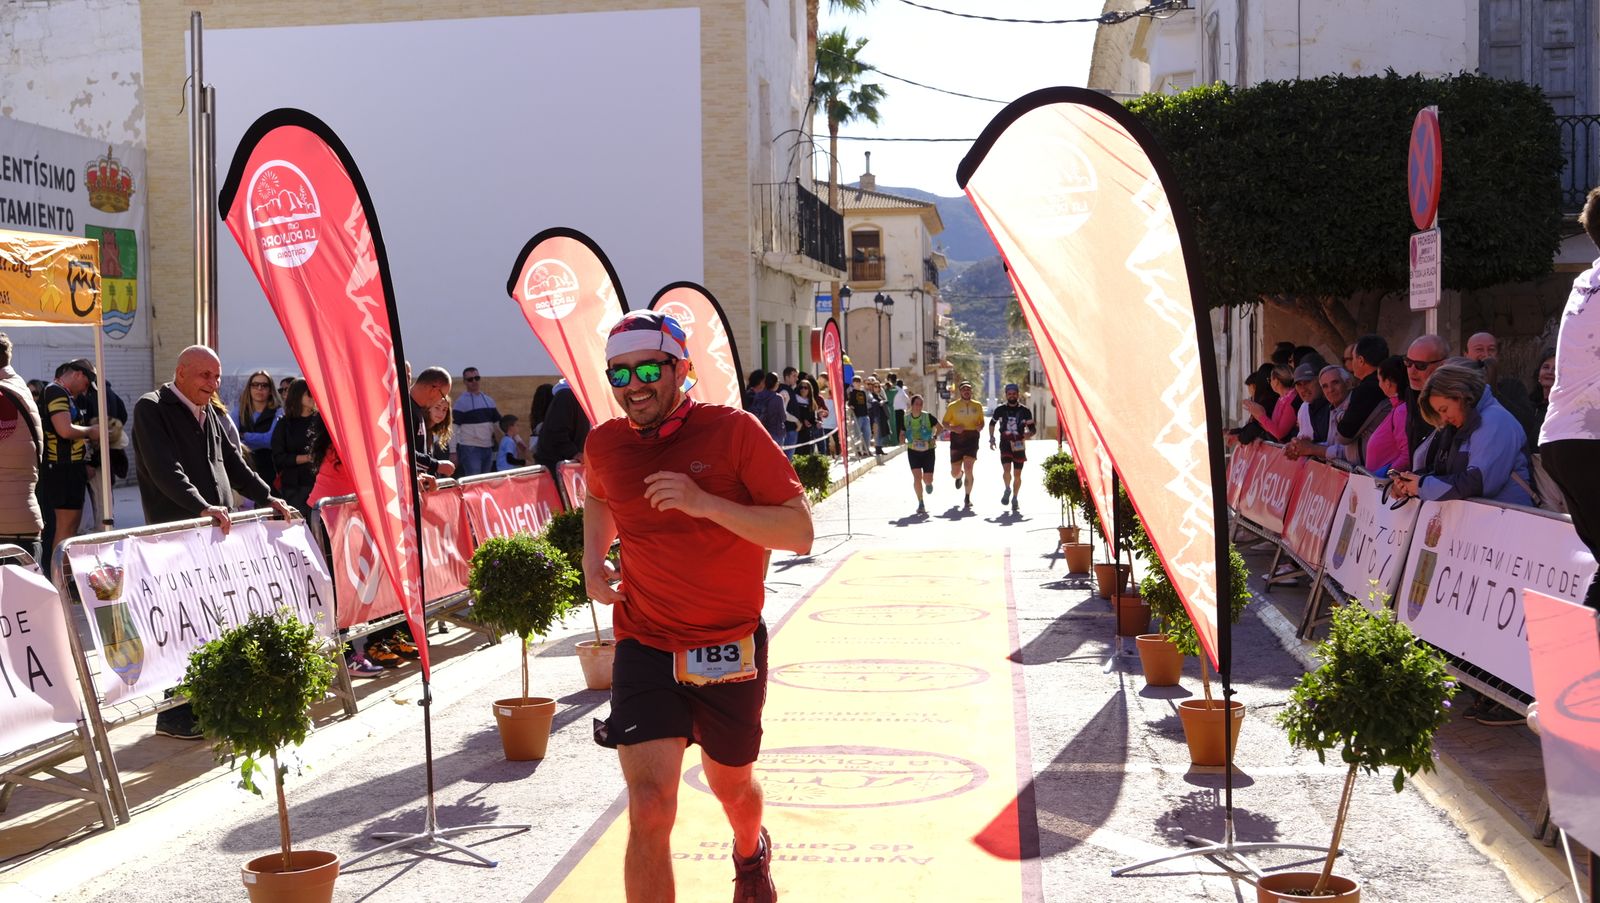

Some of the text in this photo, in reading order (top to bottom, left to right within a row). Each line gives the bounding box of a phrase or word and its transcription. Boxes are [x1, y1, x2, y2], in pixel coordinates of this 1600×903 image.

[0, 154, 76, 193] ENTÍSIMO
[1261, 472, 1291, 510] EOLIA
[422, 522, 468, 568] LIA
[141, 549, 311, 597] AYUNTAMIENTO DE
[1449, 539, 1580, 598] AYUNTAMIENTO DE
[0, 610, 31, 638] DE
[149, 575, 323, 648] CANTORIA
[689, 644, 740, 663] 183
[757, 758, 895, 766] POLVOR
[671, 852, 935, 865] Ayuntamnto
[699, 842, 914, 853] de Cantia
